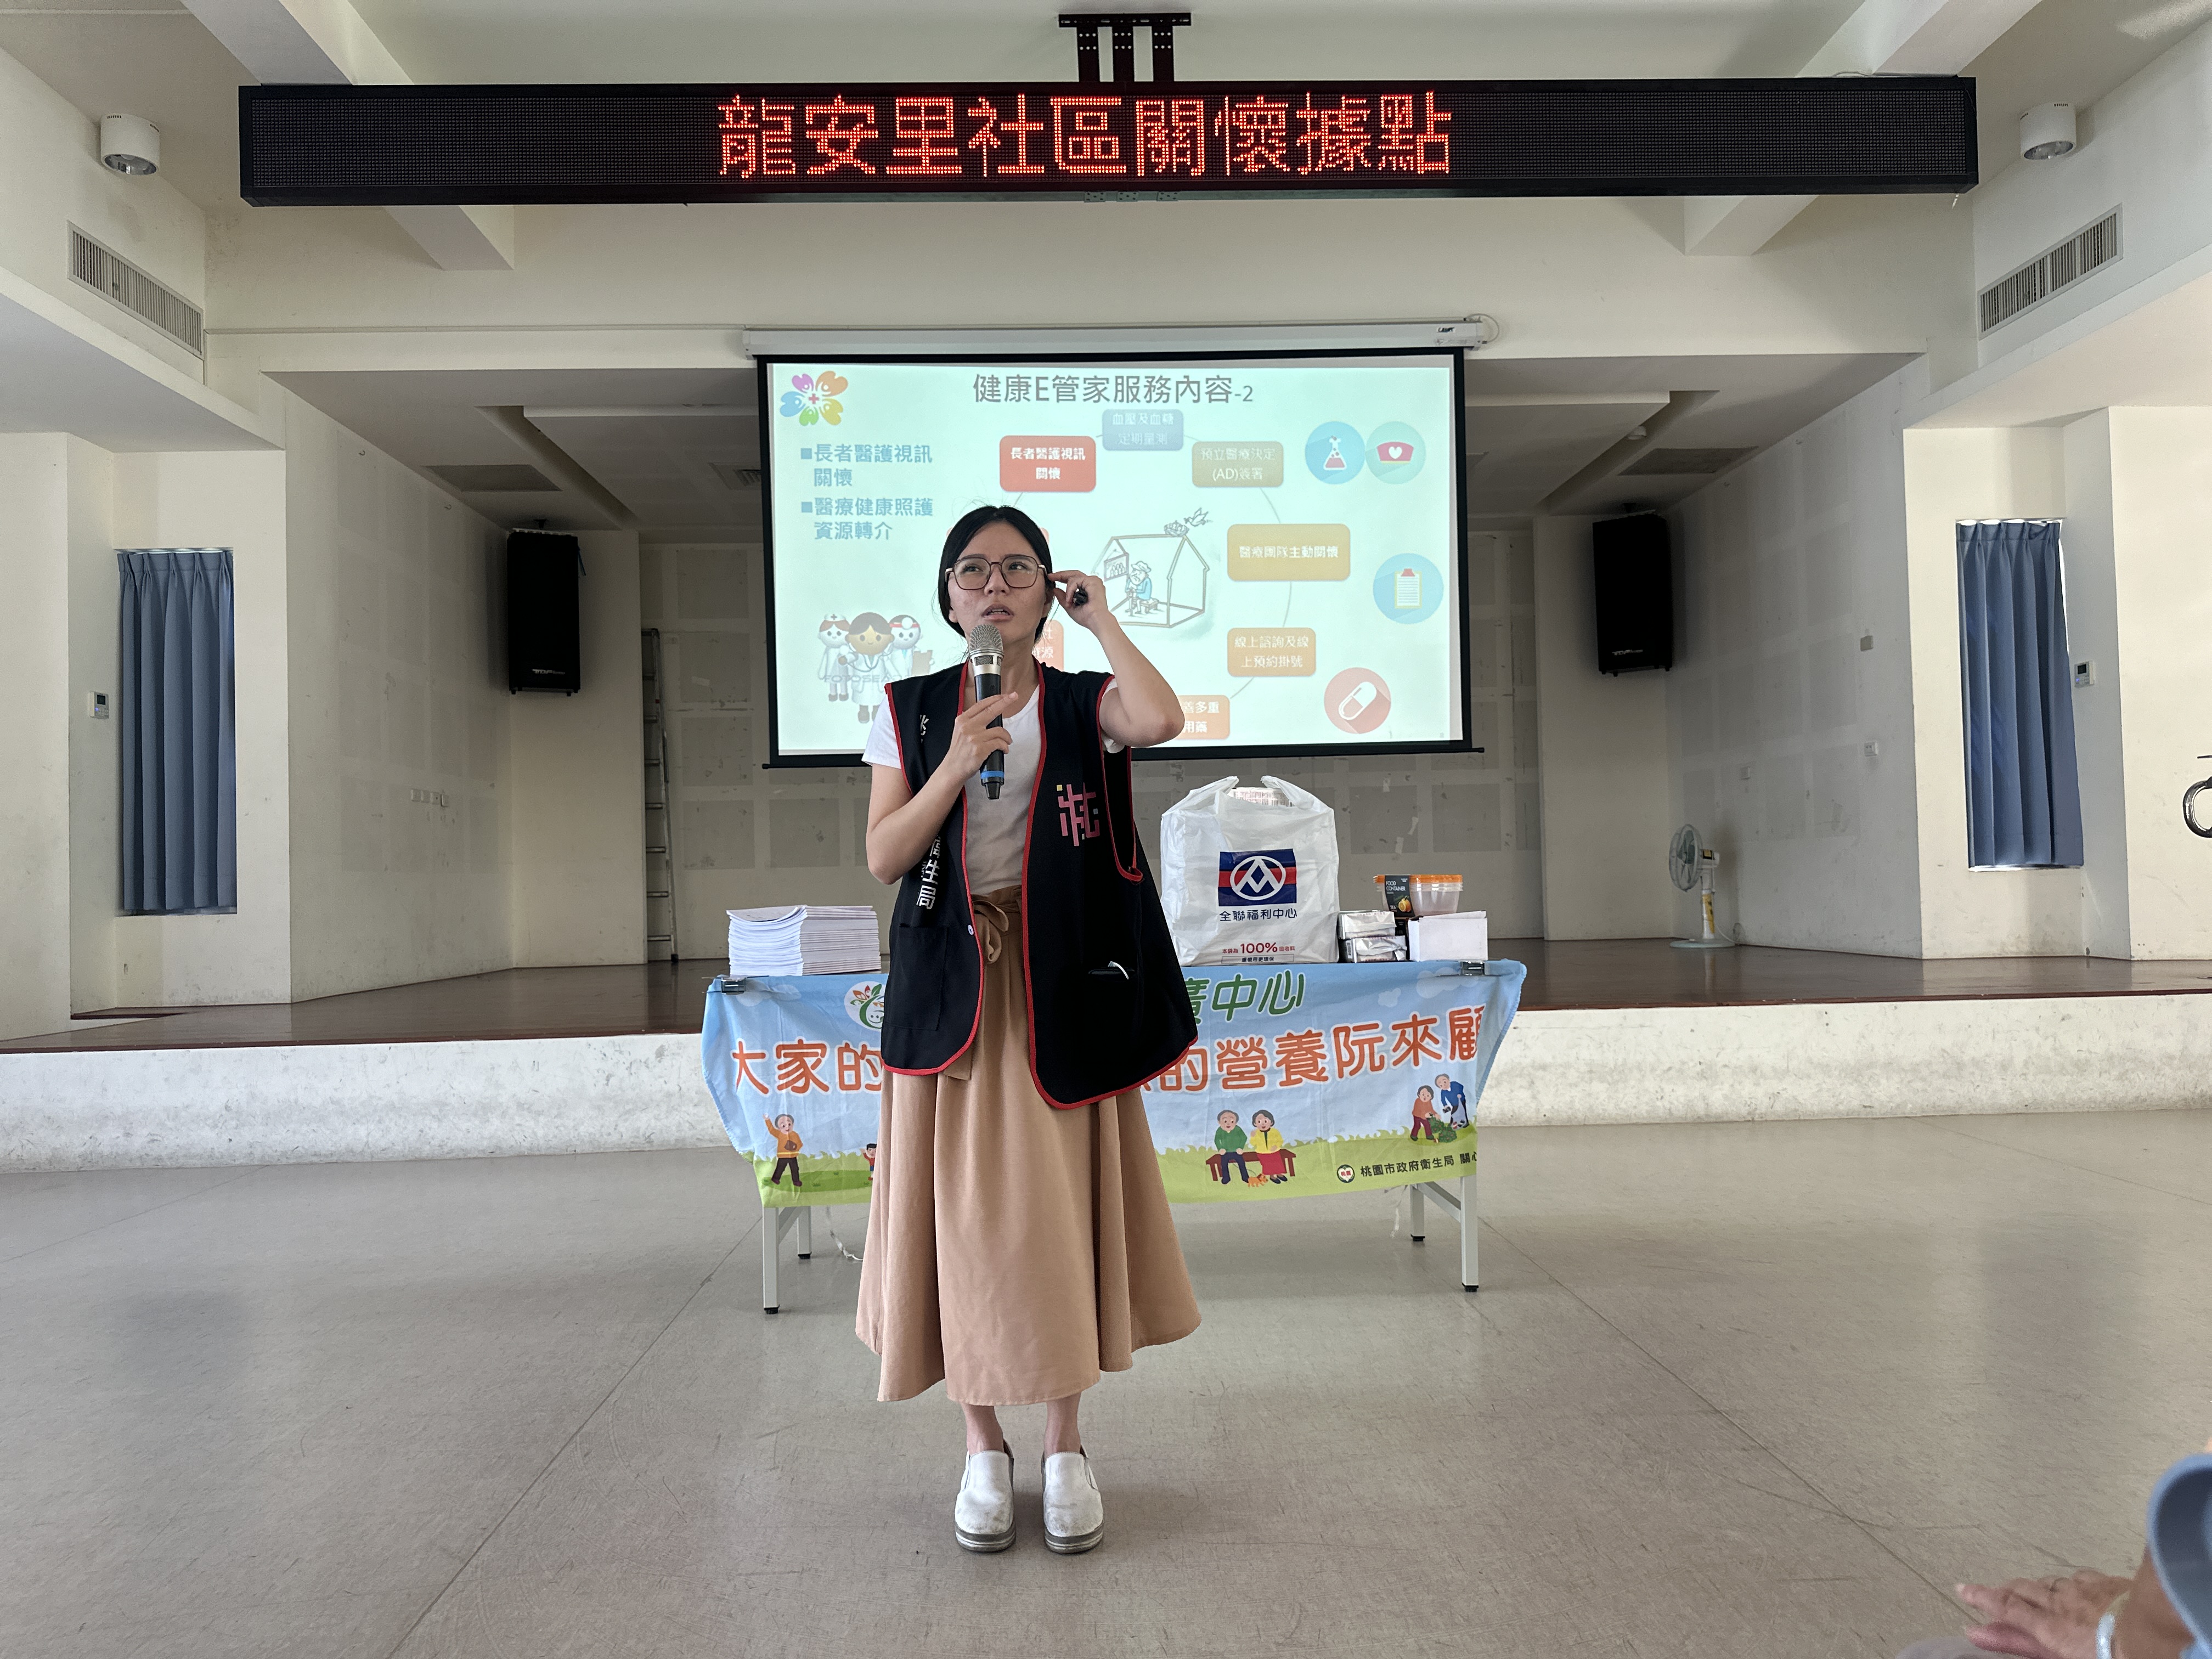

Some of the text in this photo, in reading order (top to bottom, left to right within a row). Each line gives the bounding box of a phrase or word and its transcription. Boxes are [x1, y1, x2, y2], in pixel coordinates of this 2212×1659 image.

[718, 91, 1452, 178] 龍安里社區關懷據點
[973, 374, 1254, 403] 健康E管家服務內容-2
[815, 444, 933, 464] 長者醫護視訊
[1011, 447, 1086, 461] 長者醫護視訊
[814, 467, 853, 487] 關懷
[1035, 467, 1061, 481] 關懷
[815, 497, 933, 517] 醫療健康照護
[815, 521, 893, 540] 資源轉介
[1239, 545, 1339, 558] 醫療團隊主動關懷
[1234, 635, 1309, 648] 線上諮詢及線
[1240, 655, 1304, 668] 上預約掛號
[1219, 907, 1297, 922] 全聯福利中心
[1240, 942, 1278, 953] 100%
[732, 1006, 1485, 1094] 大家的 的營養阮來顧
[1360, 1155, 1455, 1177] 桃園市政府衛生局
